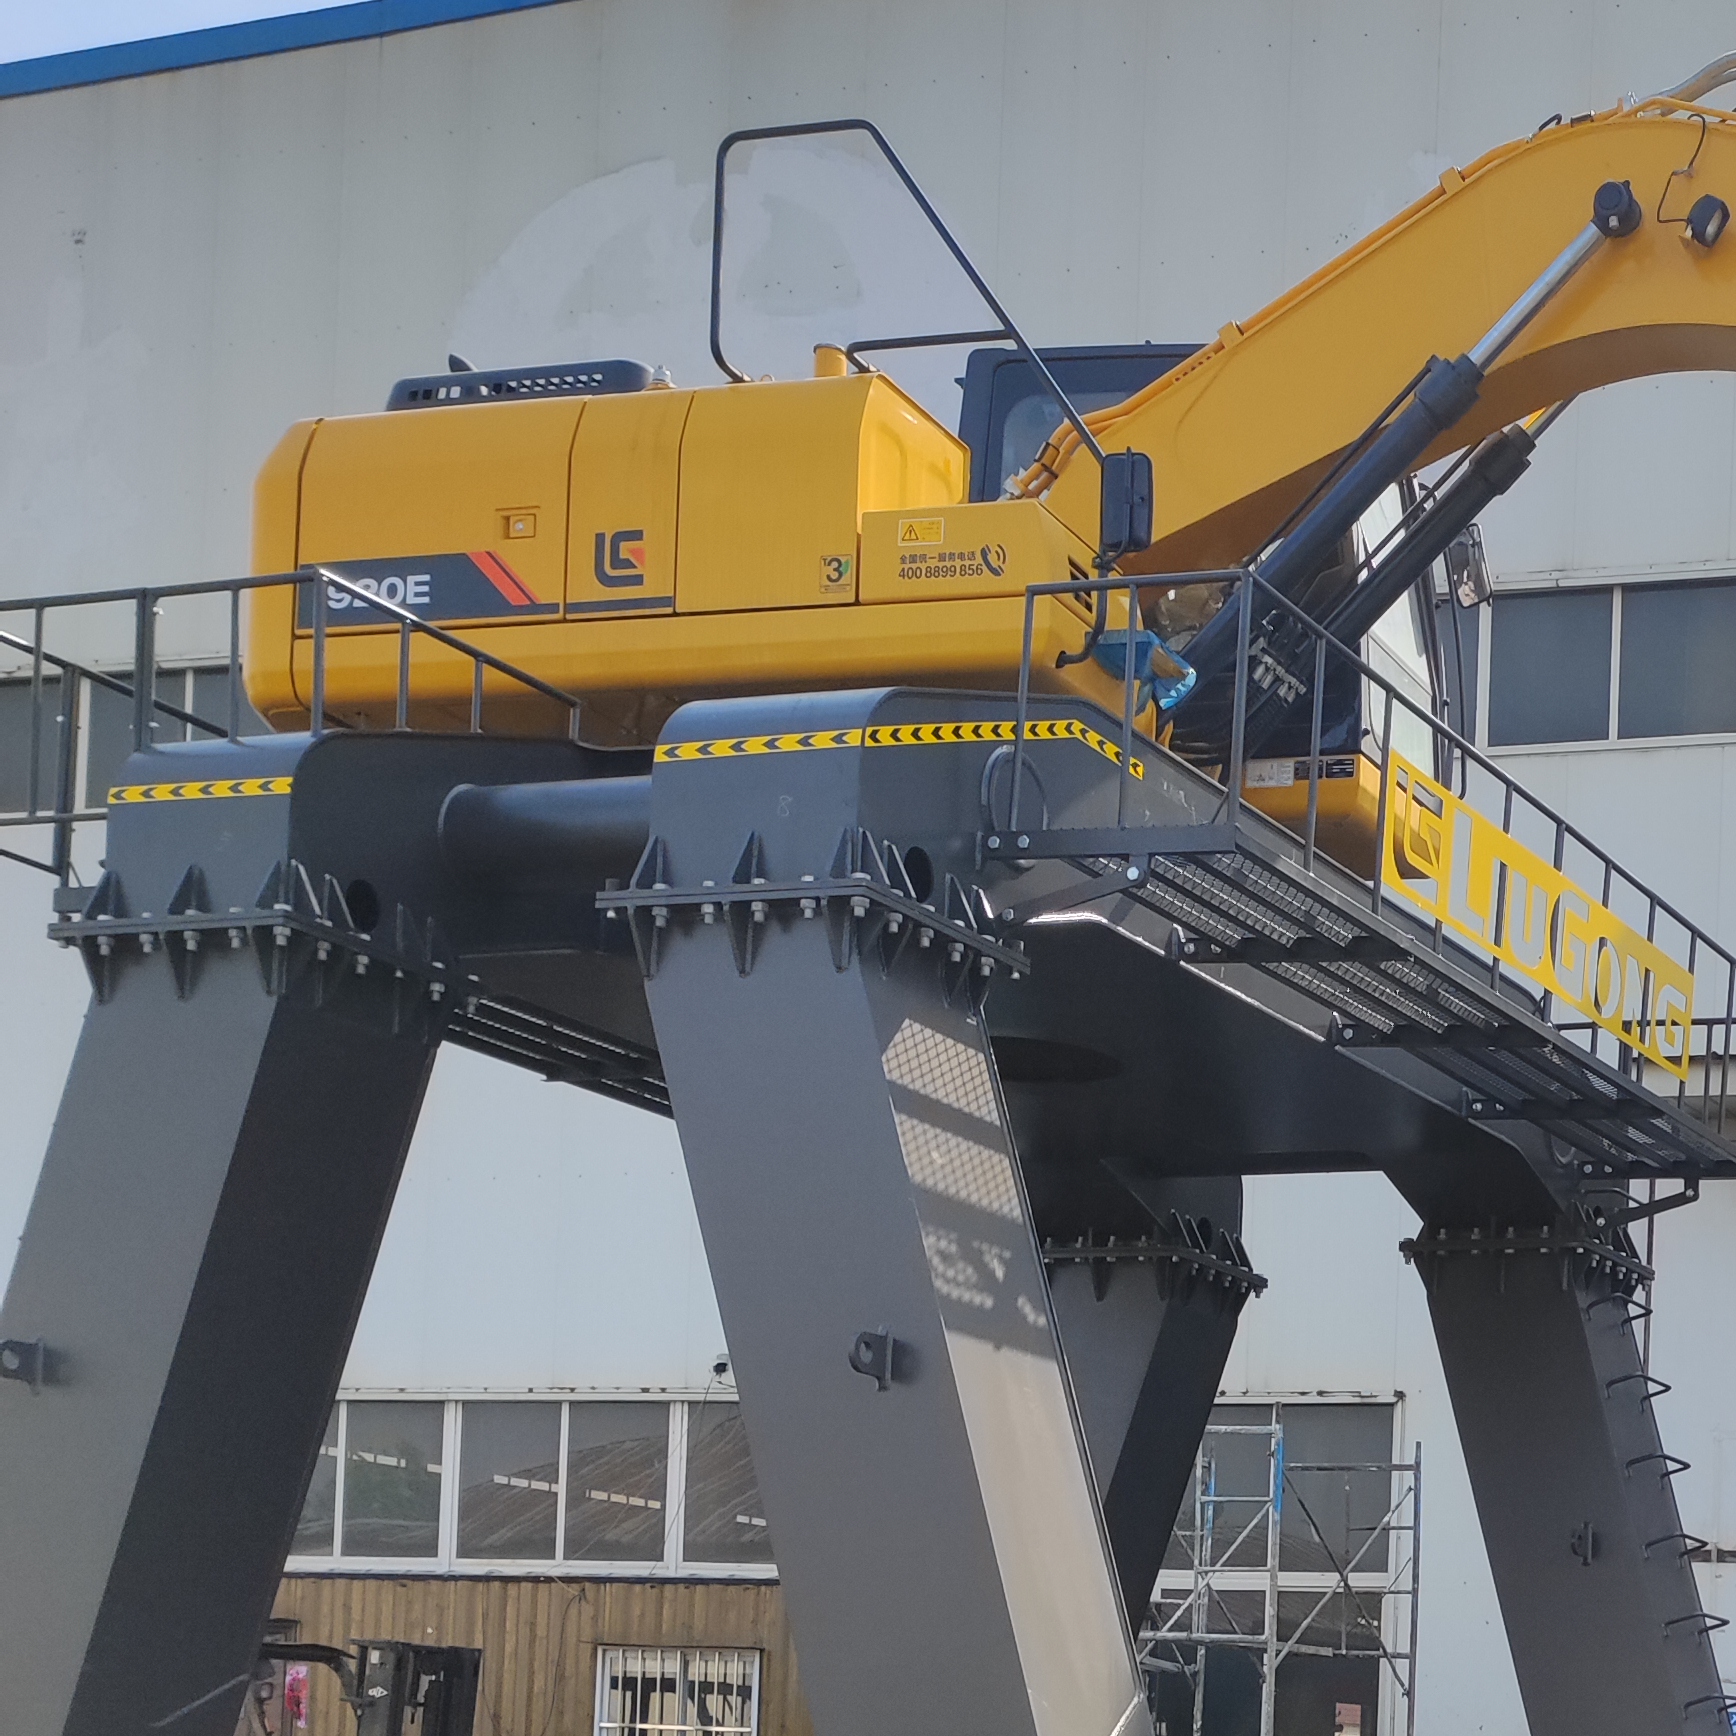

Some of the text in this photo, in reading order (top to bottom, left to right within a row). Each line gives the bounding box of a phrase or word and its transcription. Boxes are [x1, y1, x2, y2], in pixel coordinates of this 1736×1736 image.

[898, 563, 984, 580] 400 8899 856
